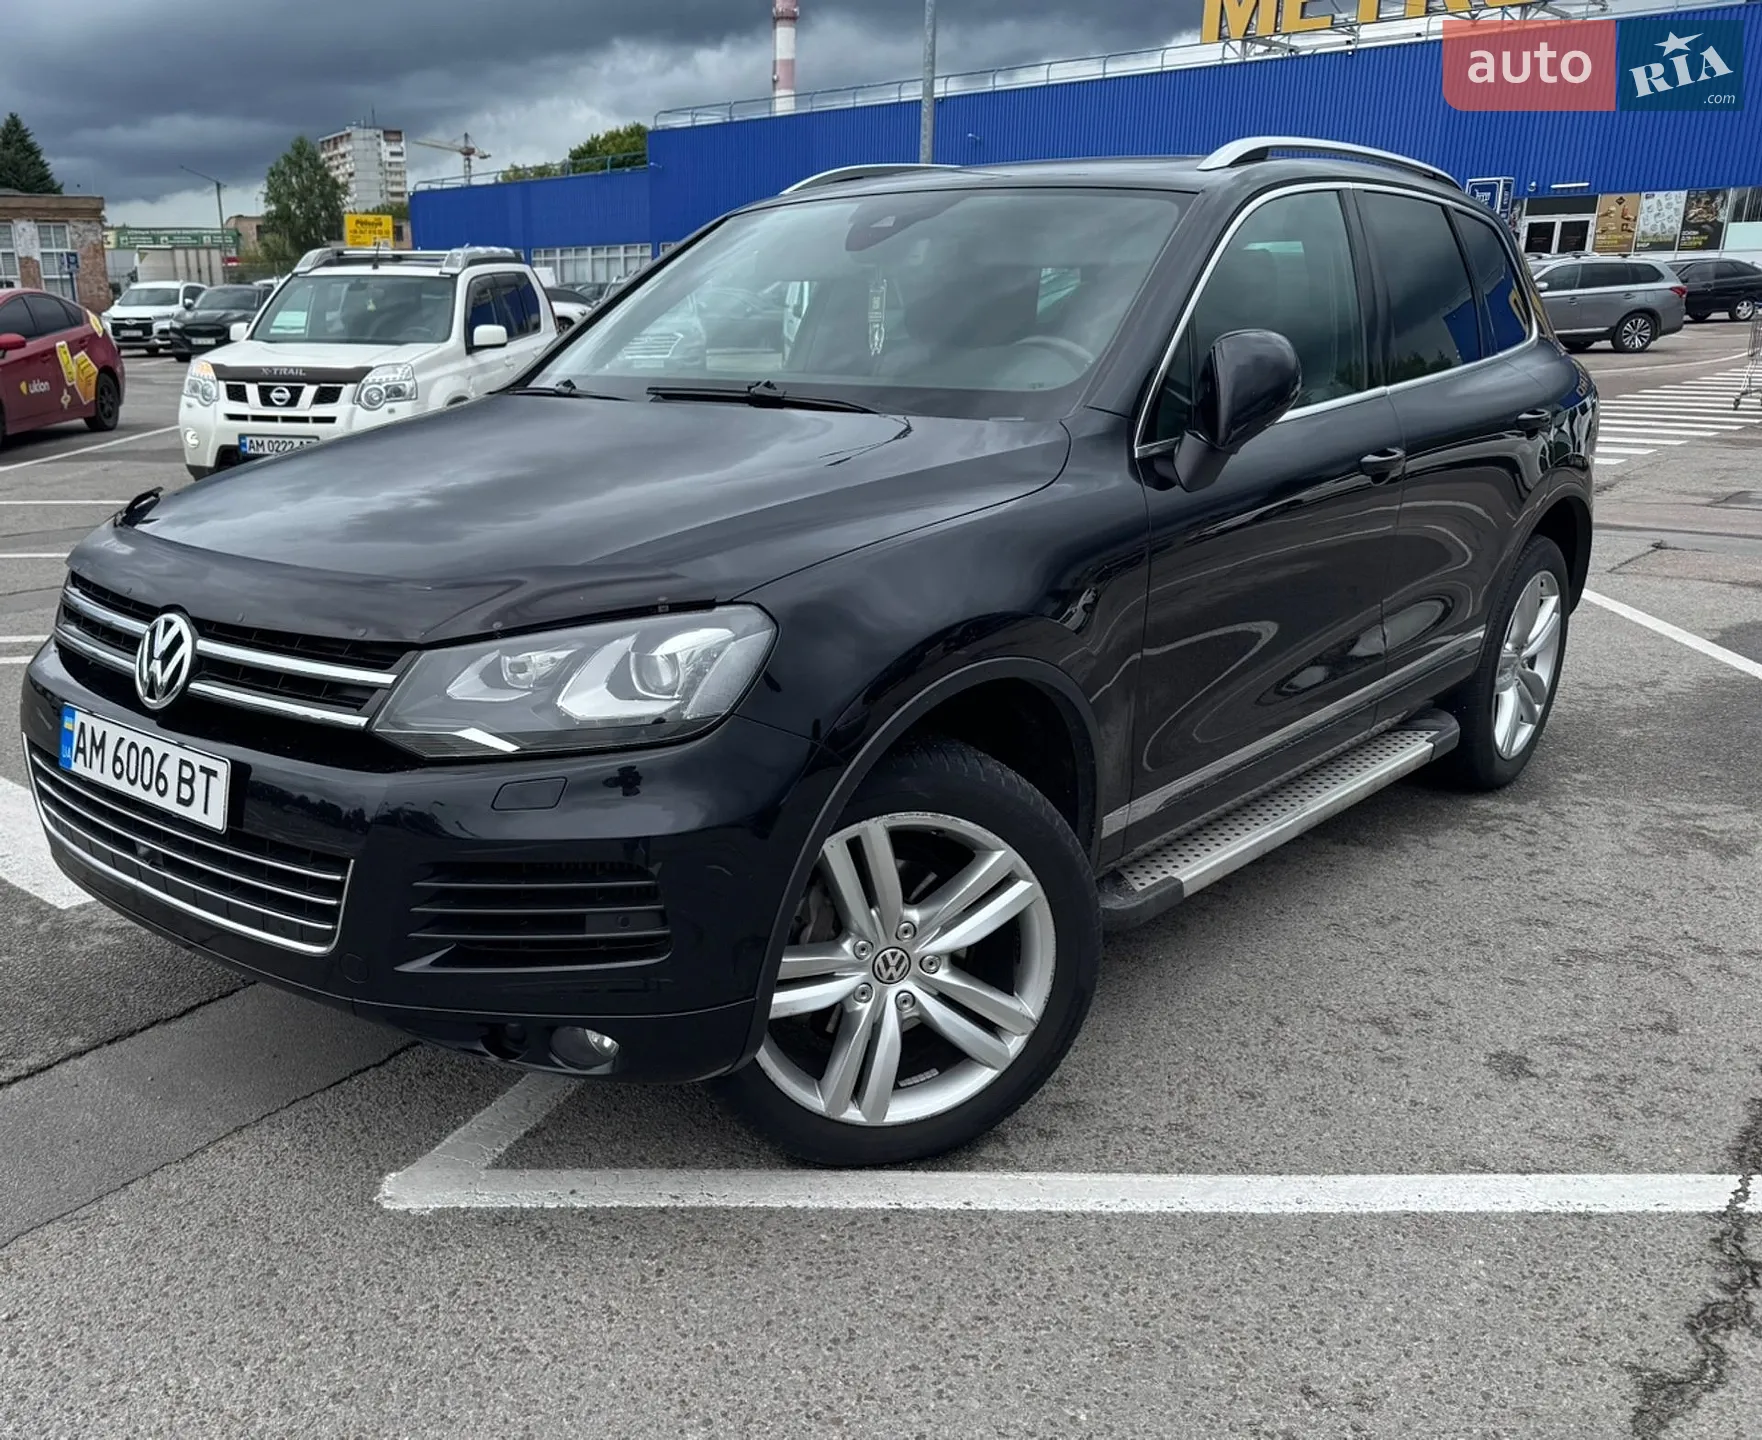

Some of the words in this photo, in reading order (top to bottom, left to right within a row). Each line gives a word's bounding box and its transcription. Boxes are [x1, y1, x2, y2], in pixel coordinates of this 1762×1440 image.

[261, 367, 306, 376] X-TRAIL
[28, 379, 50, 394] uklon
[248, 439, 265, 452] AM
[74, 722, 106, 774] AM
[112, 737, 170, 797] 6006
[176, 758, 218, 815] BT
